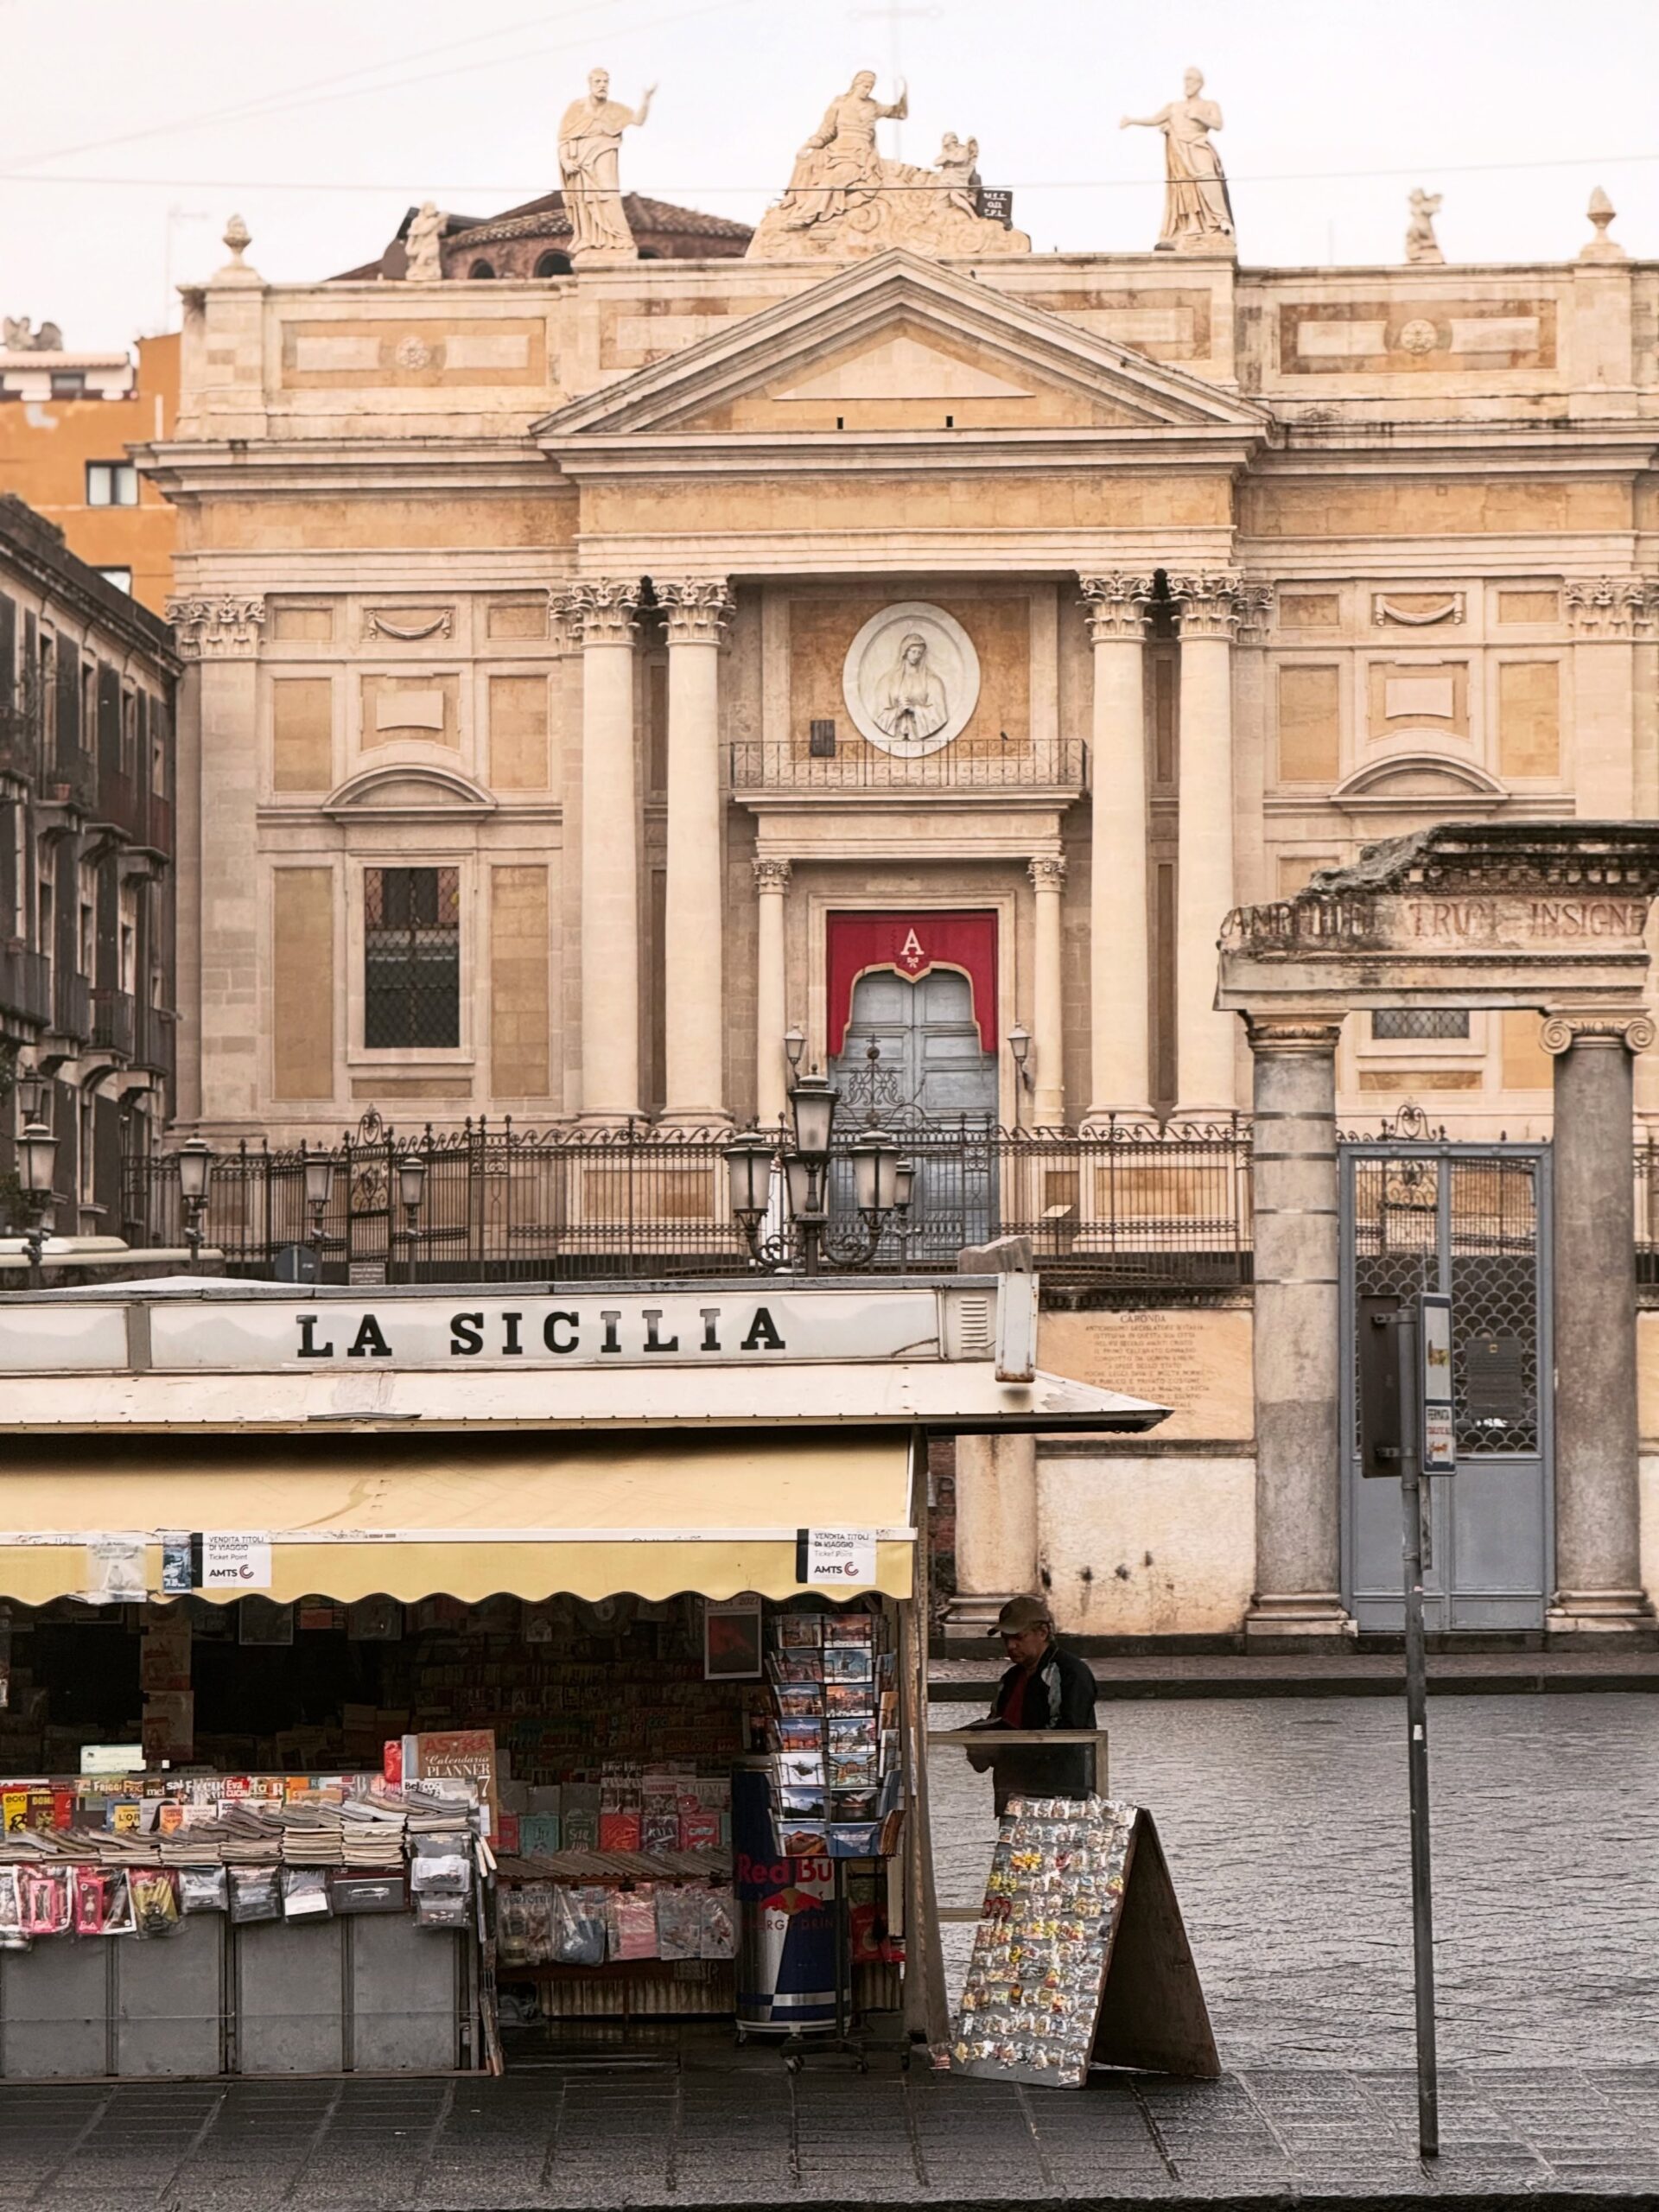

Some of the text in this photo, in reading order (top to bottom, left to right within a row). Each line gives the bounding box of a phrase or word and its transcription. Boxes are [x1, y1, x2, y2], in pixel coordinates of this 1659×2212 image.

[1531, 902, 1647, 937] INSIGNE
[900, 928, 925, 956] A
[1120, 1314, 1166, 1323] CARONDA
[296, 1307, 786, 1357] LA SICILIA
[814, 1566, 843, 1574] AMTS
[425, 1753, 490, 1765] Calendario
[427, 1763, 490, 1777] PLANNER
[736, 1852, 833, 1885] Red Bu
